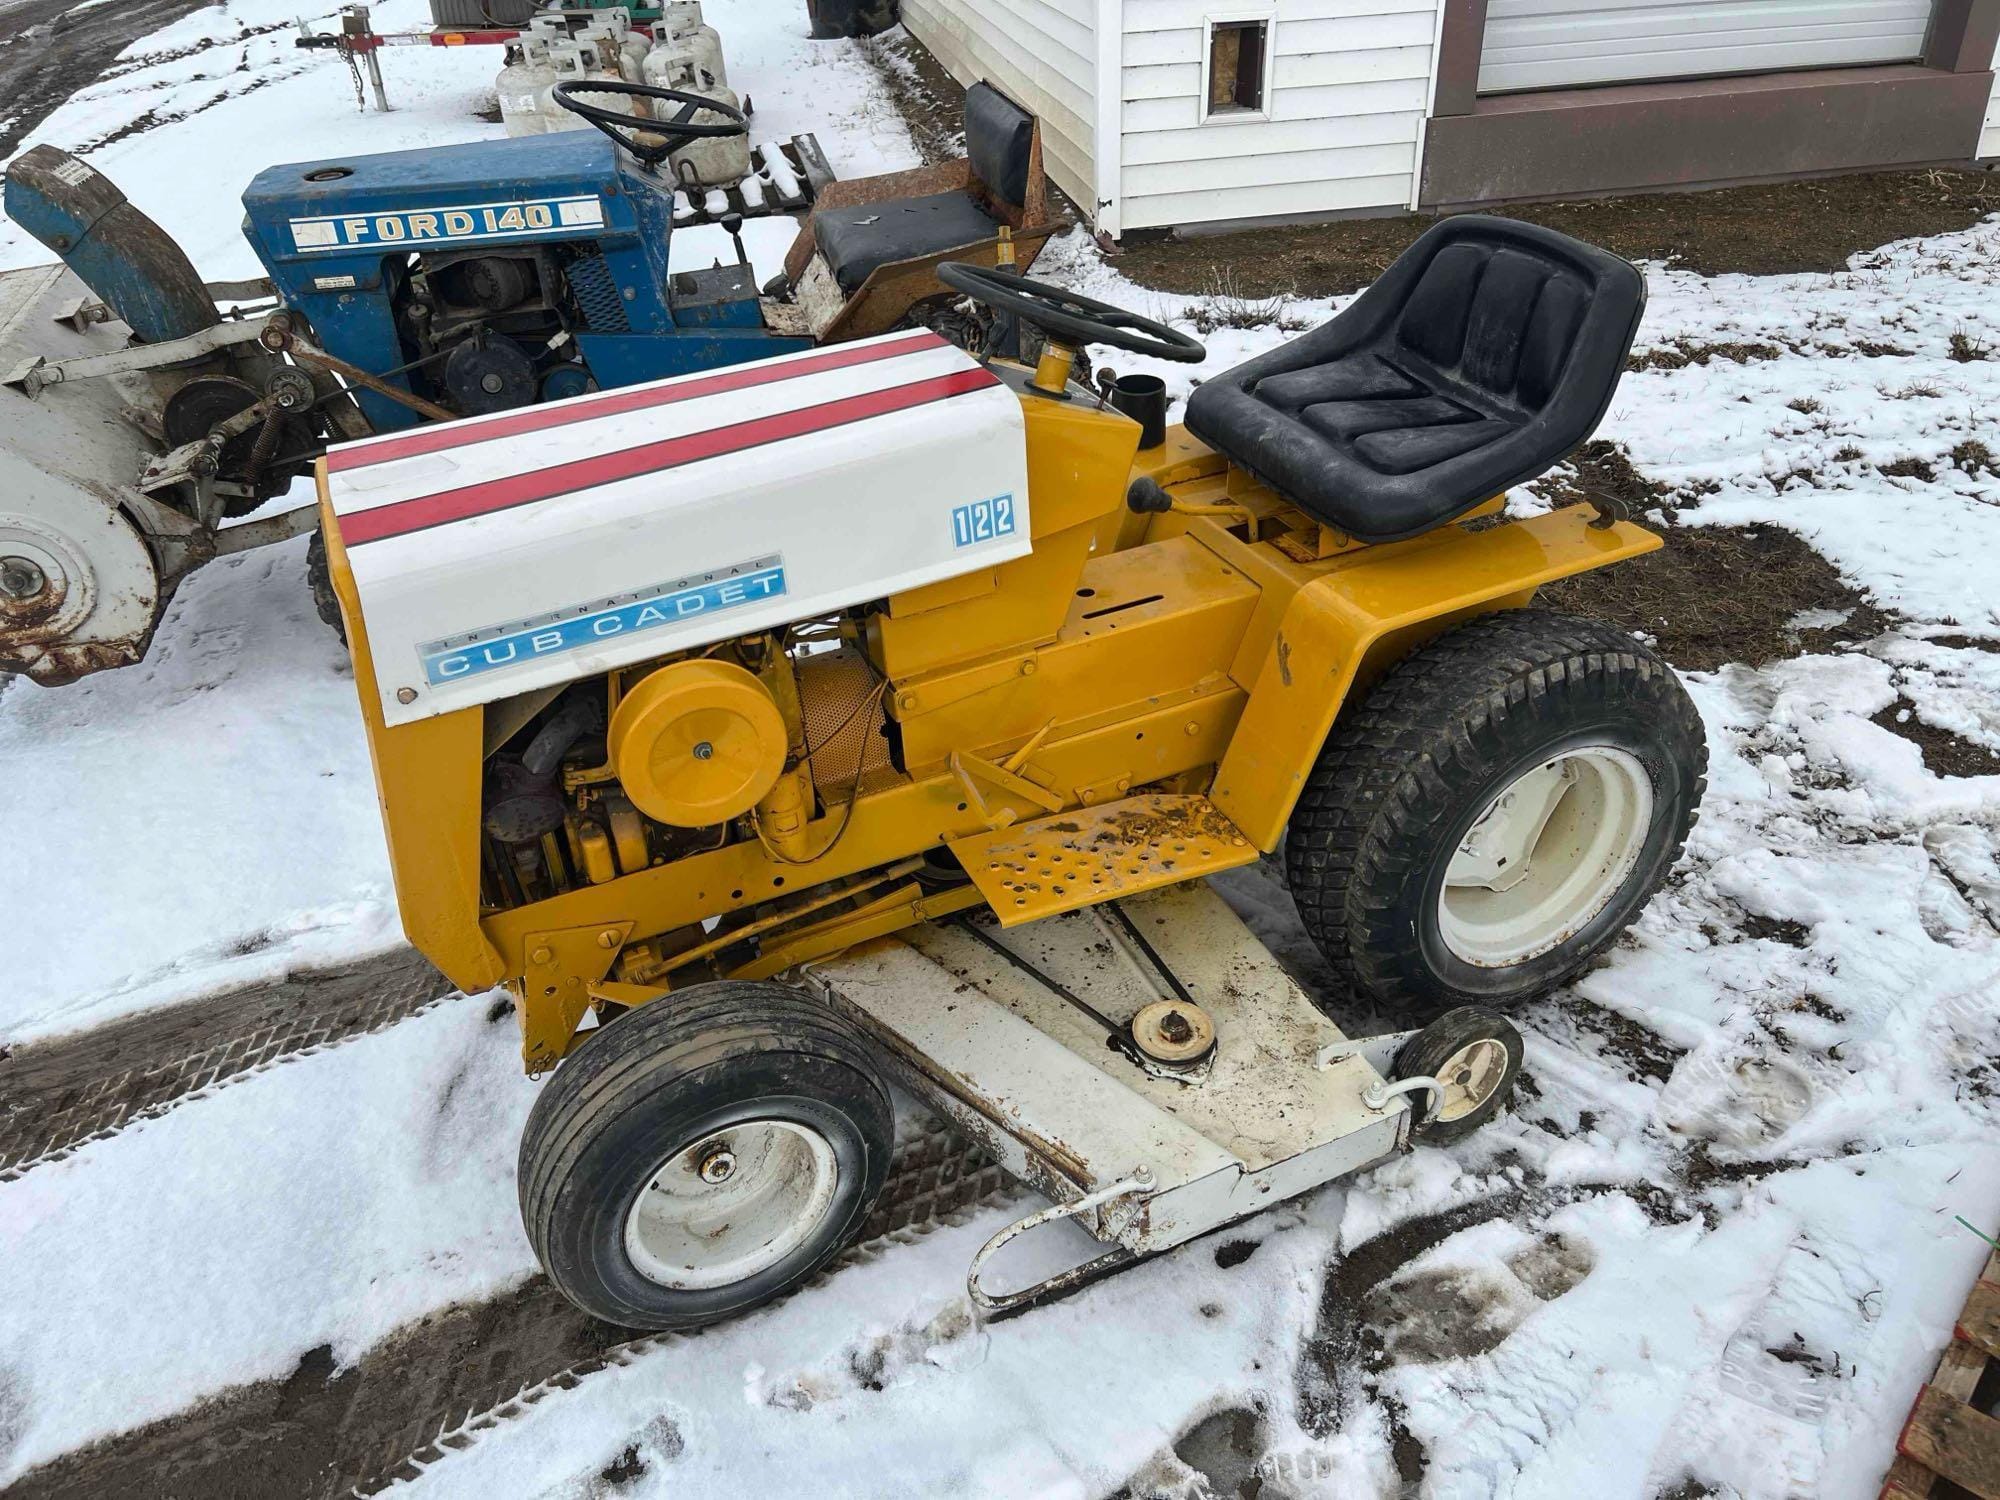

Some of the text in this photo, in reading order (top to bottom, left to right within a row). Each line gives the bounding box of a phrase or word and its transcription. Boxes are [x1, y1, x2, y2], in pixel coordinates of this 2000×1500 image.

[343, 204, 553, 244] FORD 140
[956, 498, 1011, 542] 122
[437, 574, 779, 677] CUB CADET
[443, 560, 764, 648] INTERNATIONAL
